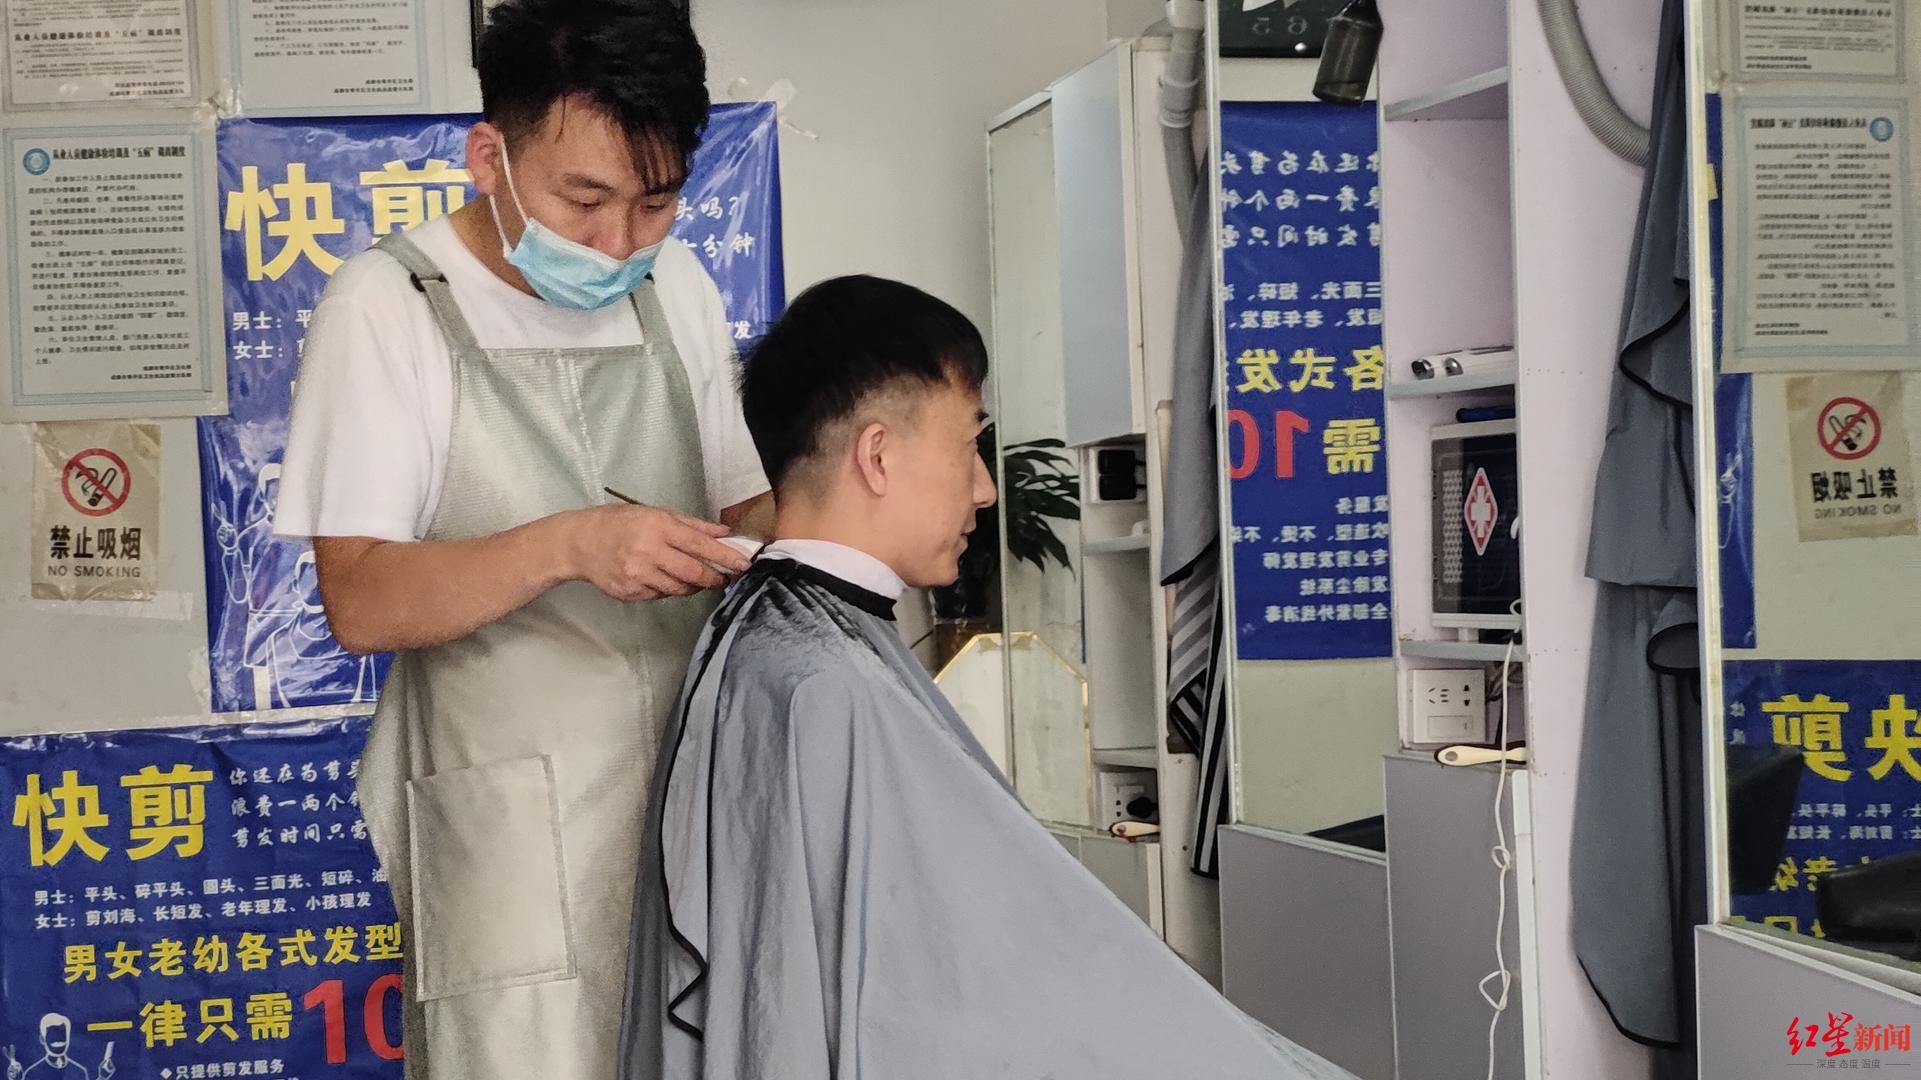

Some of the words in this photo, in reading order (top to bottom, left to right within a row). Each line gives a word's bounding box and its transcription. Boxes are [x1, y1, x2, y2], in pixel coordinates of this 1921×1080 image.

[224, 158, 475, 282] 快剪
[48, 566, 69, 577] NO
[74, 566, 141, 578] SMOKING
[50, 525, 142, 560] 禁止吸烟
[12, 763, 214, 868] 快剪
[63, 921, 404, 984] 男女老幼各式发型
[87, 992, 293, 1049] 一律只需
